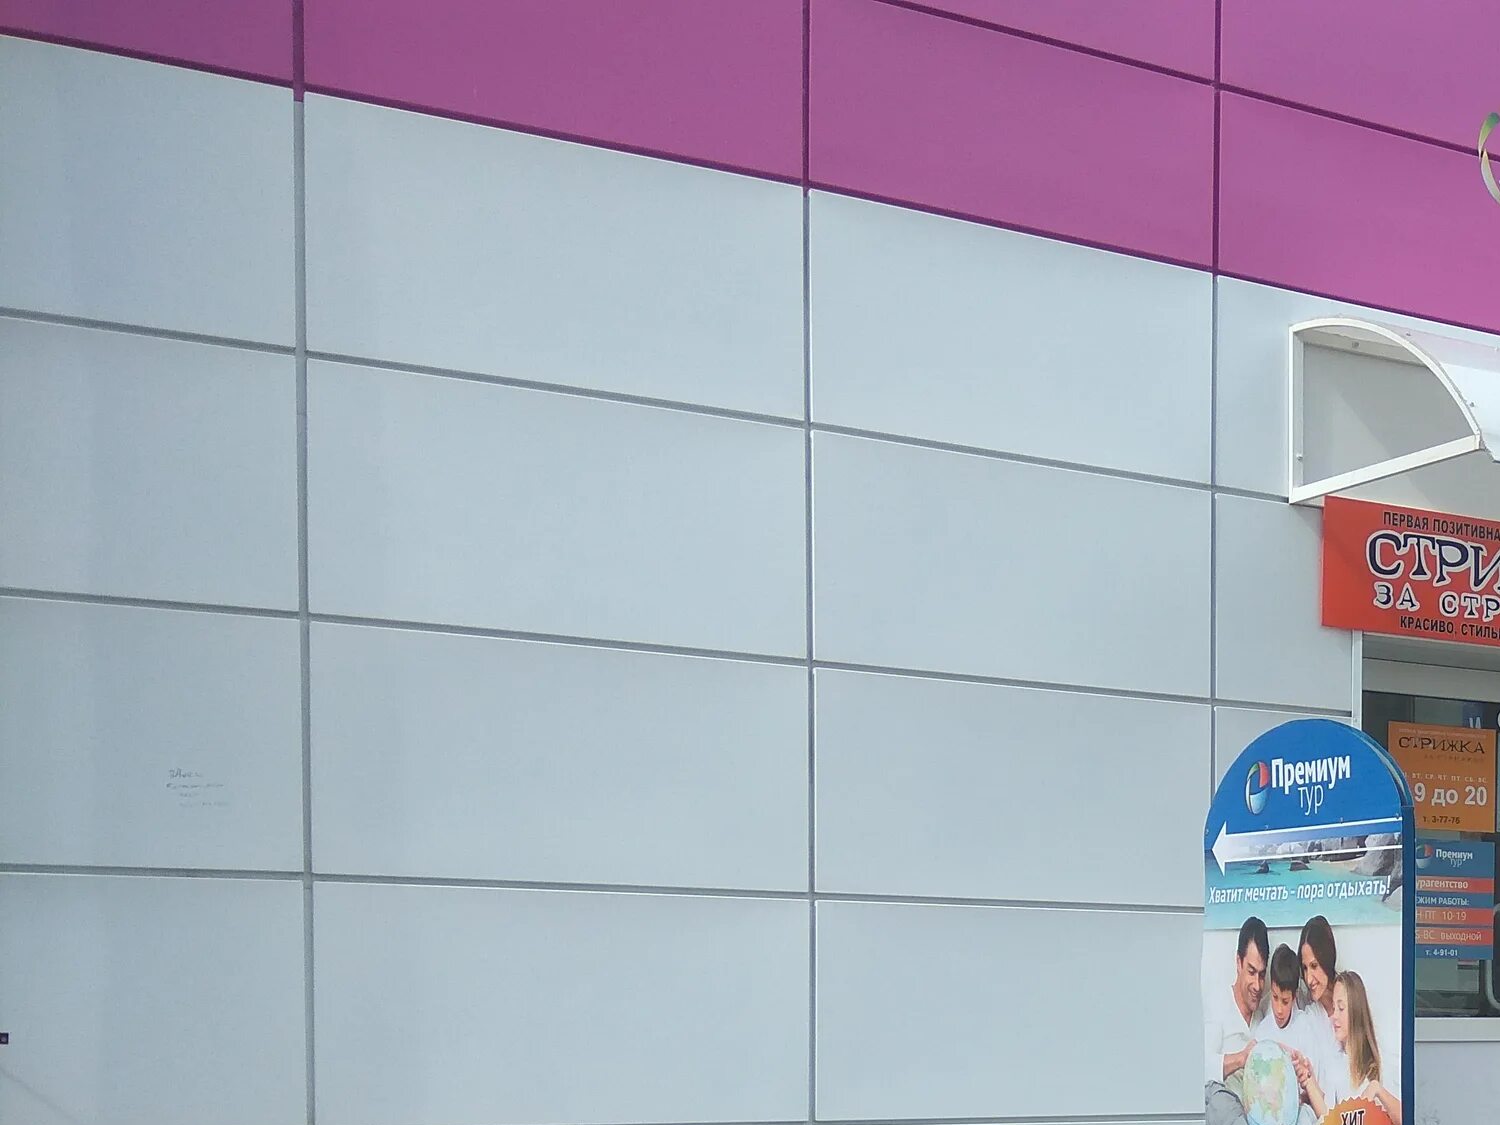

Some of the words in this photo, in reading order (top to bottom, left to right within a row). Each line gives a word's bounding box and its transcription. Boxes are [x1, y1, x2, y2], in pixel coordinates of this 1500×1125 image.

[1383, 511, 1429, 531] ПЕРВАЯ
[1374, 583, 1419, 610] ЗА
[1400, 615, 1457, 635] КРАСИВО,
[1398, 736, 1485, 755] СТРИЖКА
[1271, 755, 1351, 795] Премиум
[1298, 785, 1324, 815] тур
[1414, 783, 1426, 802] 9
[1431, 788, 1459, 807] до
[1464, 786, 1488, 806] 20
[1435, 849, 1473, 861] Премиум
[1208, 886, 1243, 904] Хватит
[1244, 886, 1289, 902] мечтать
[1296, 883, 1324, 902] пора
[1326, 875, 1391, 899] отдыхать!
[1443, 911, 1467, 921] 10-19
